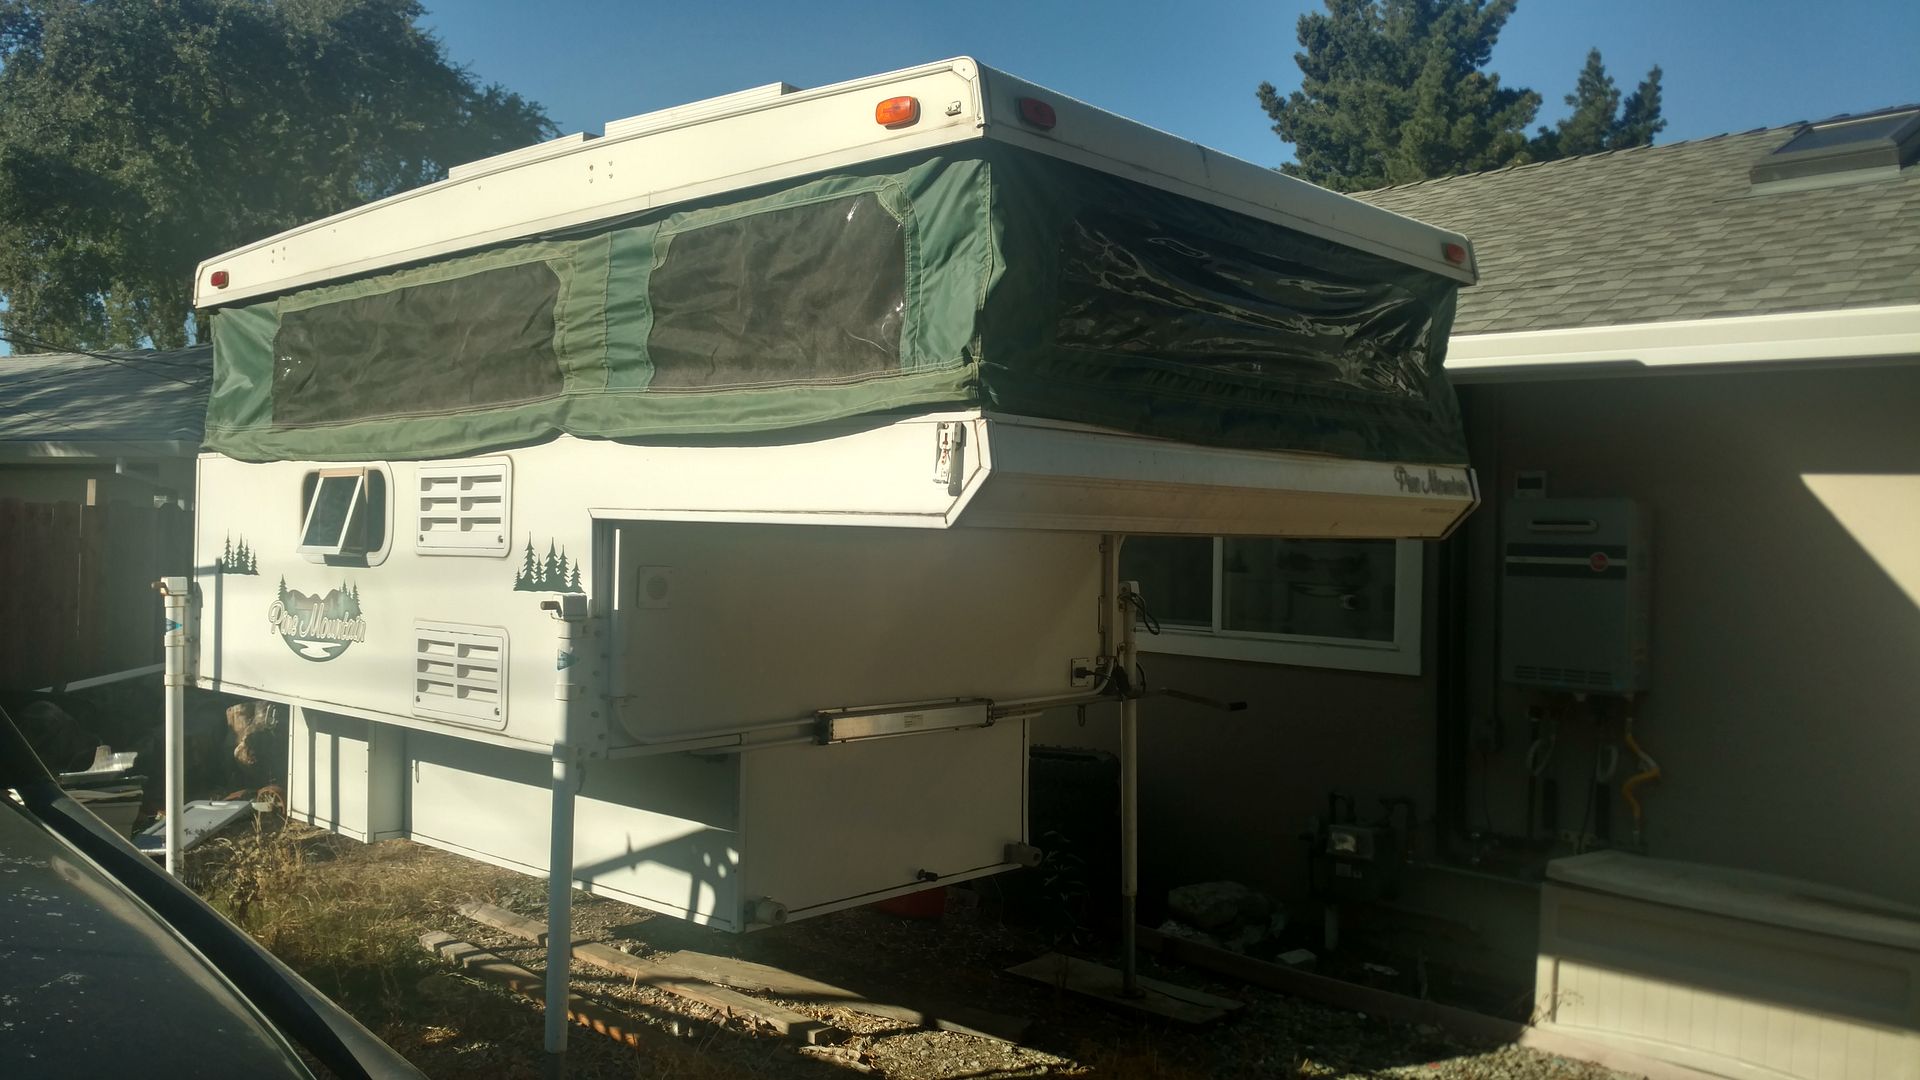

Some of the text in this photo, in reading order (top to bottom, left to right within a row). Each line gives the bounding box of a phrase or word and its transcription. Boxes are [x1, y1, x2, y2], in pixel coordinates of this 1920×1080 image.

[1394, 465, 1420, 493] Pi
[269, 600, 366, 643] Pine Mountain
